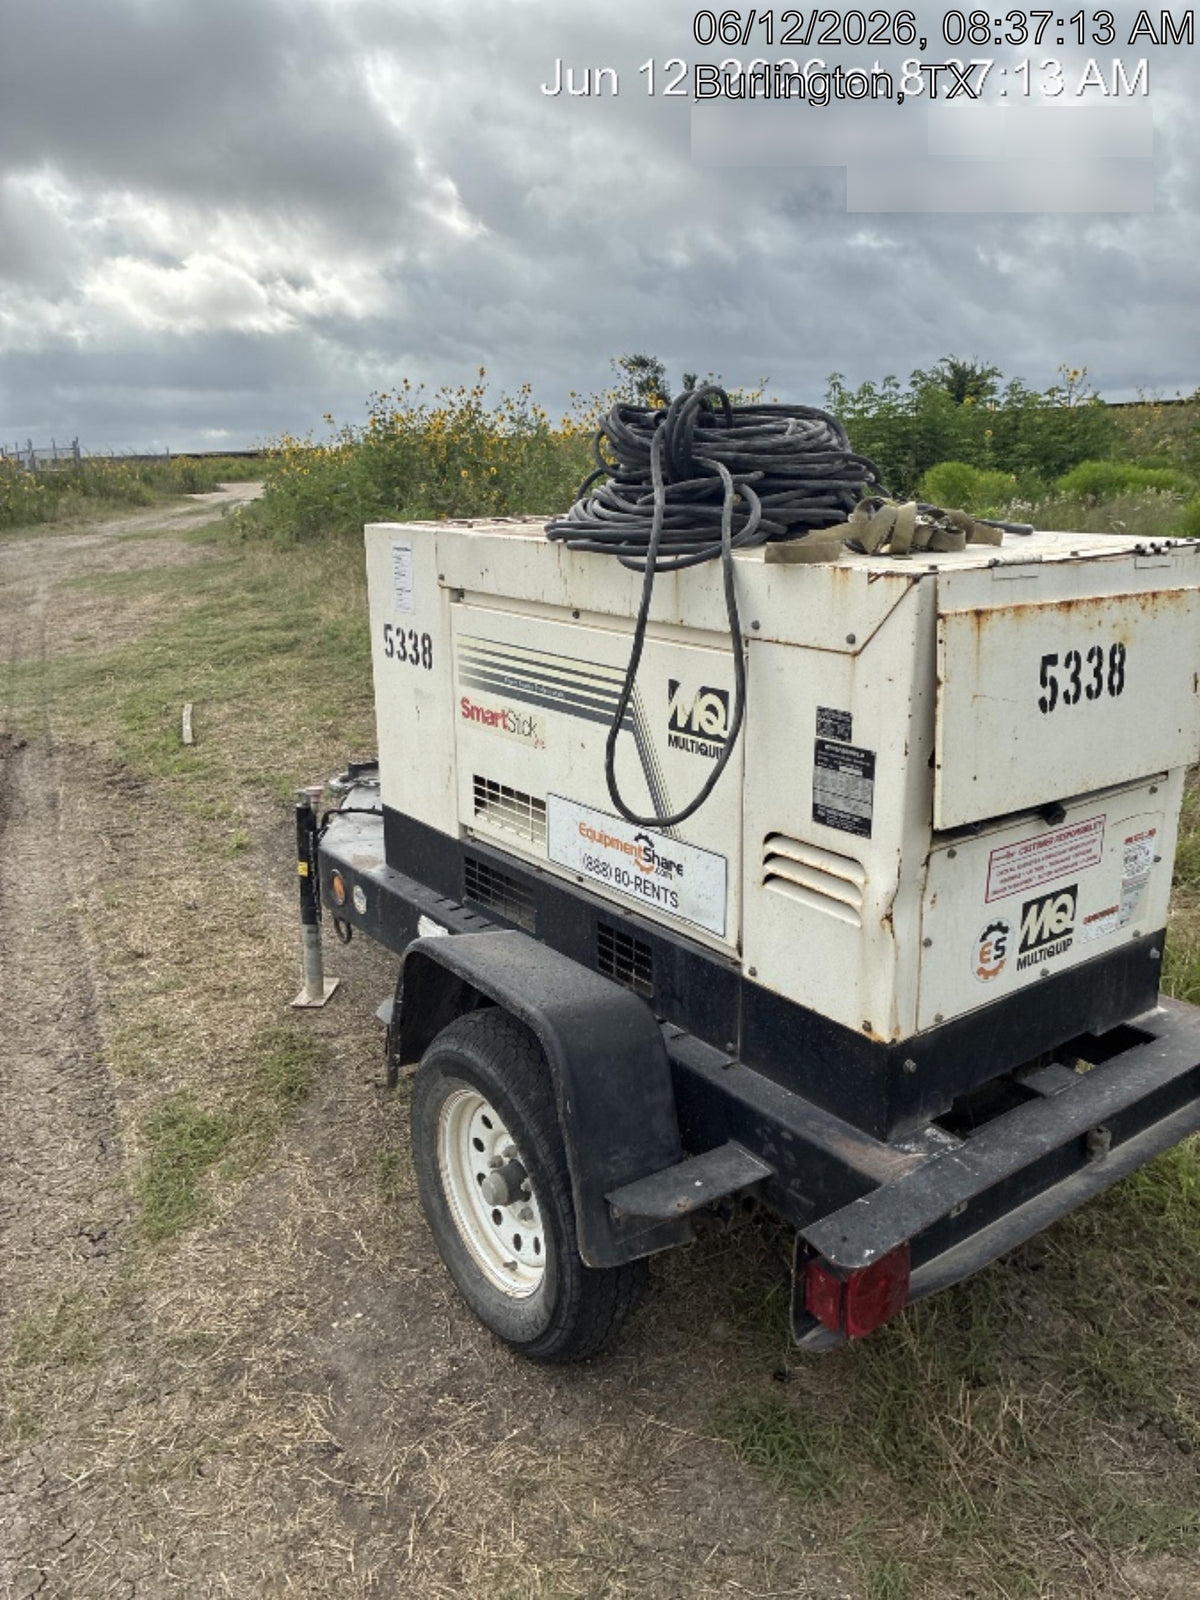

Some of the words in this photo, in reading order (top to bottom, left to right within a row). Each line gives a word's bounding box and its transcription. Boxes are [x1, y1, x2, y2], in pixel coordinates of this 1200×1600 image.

[383, 623, 433, 671] 5338
[1038, 641, 1126, 715] 5338
[582, 852, 612, 881] (888)
[614, 866, 680, 909] 80-RENTS
[1018, 884, 1078, 954] MQ
[1016, 937, 1074, 972] MULTIQUIP
